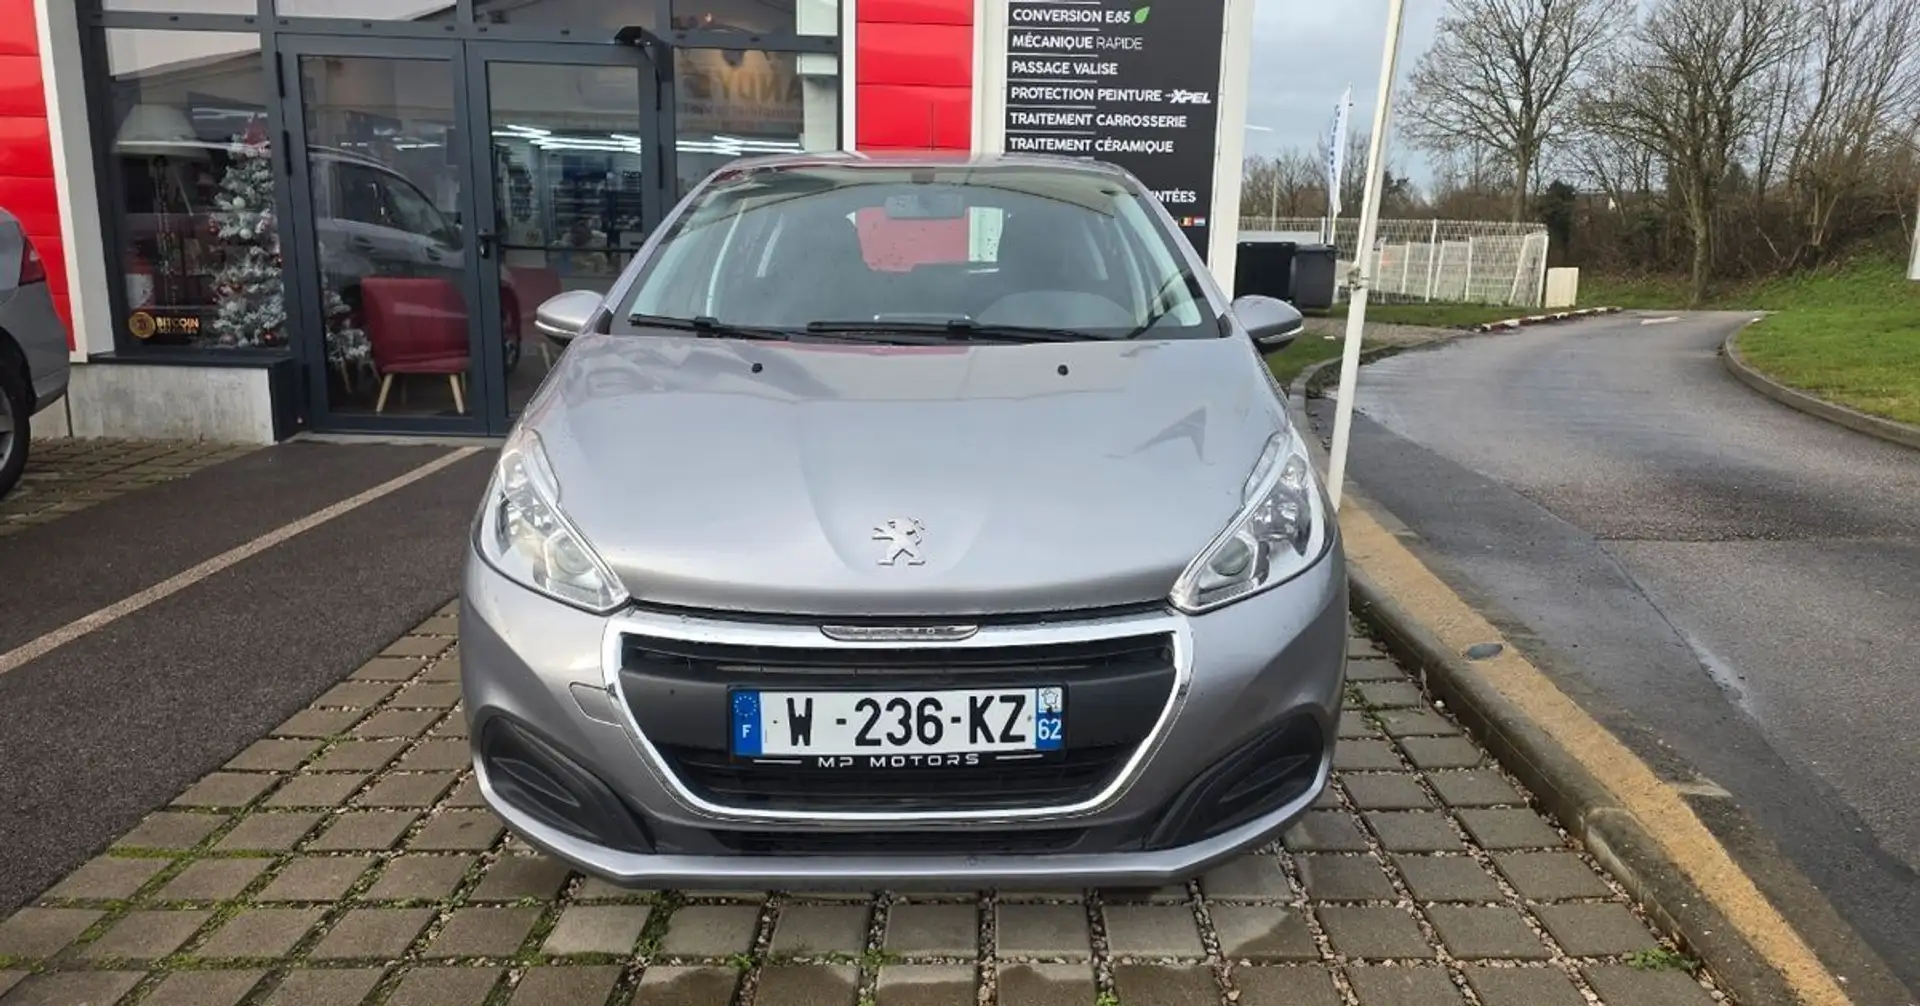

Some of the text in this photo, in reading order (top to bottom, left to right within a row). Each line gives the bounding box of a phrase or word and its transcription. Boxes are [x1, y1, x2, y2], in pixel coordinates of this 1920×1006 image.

[1013, 9, 1131, 23] CONVERSION E85
[1012, 32, 1143, 50] MÉCANIQUE RAPIDE
[1012, 61, 1118, 75] PASSAGE VALISE
[1011, 86, 1094, 100] PROTECTION
[1098, 89, 1162, 102] PEINTURE
[1010, 112, 1187, 128] TRAITEMENT CARROSSERIE
[1010, 137, 1174, 154] TRAITEMENT CÉRAMIQUE
[741, 724, 751, 738] F
[1038, 719, 1062, 740] 62
[817, 754, 979, 768] MP MOTORS
